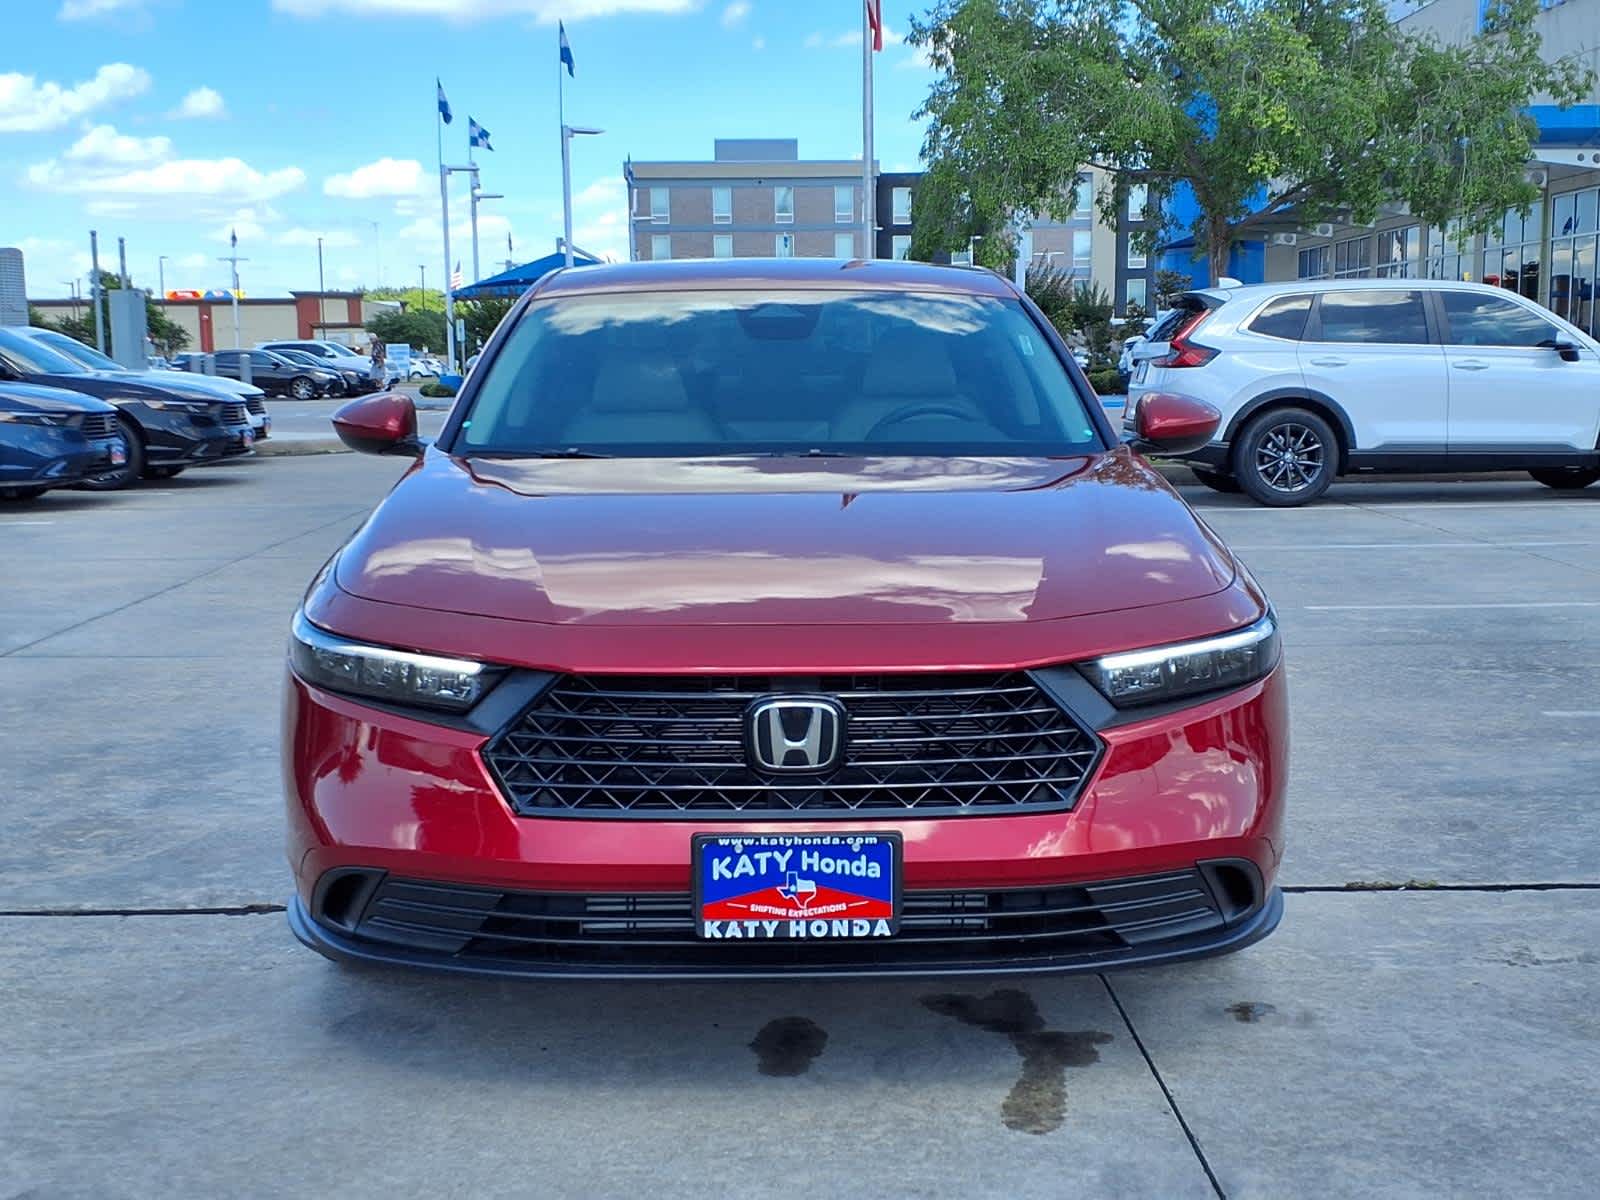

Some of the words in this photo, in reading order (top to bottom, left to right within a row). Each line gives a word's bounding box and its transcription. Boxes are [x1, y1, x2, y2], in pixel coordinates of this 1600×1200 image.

[718, 836, 878, 847] www.katyhonda.com
[712, 848, 793, 881] KATY
[801, 849, 881, 879] Honda
[750, 903, 787, 916] SHIFTING
[788, 902, 847, 917] EXPECTATIONS
[704, 919, 780, 939] KATY
[789, 919, 892, 938] HONDA
